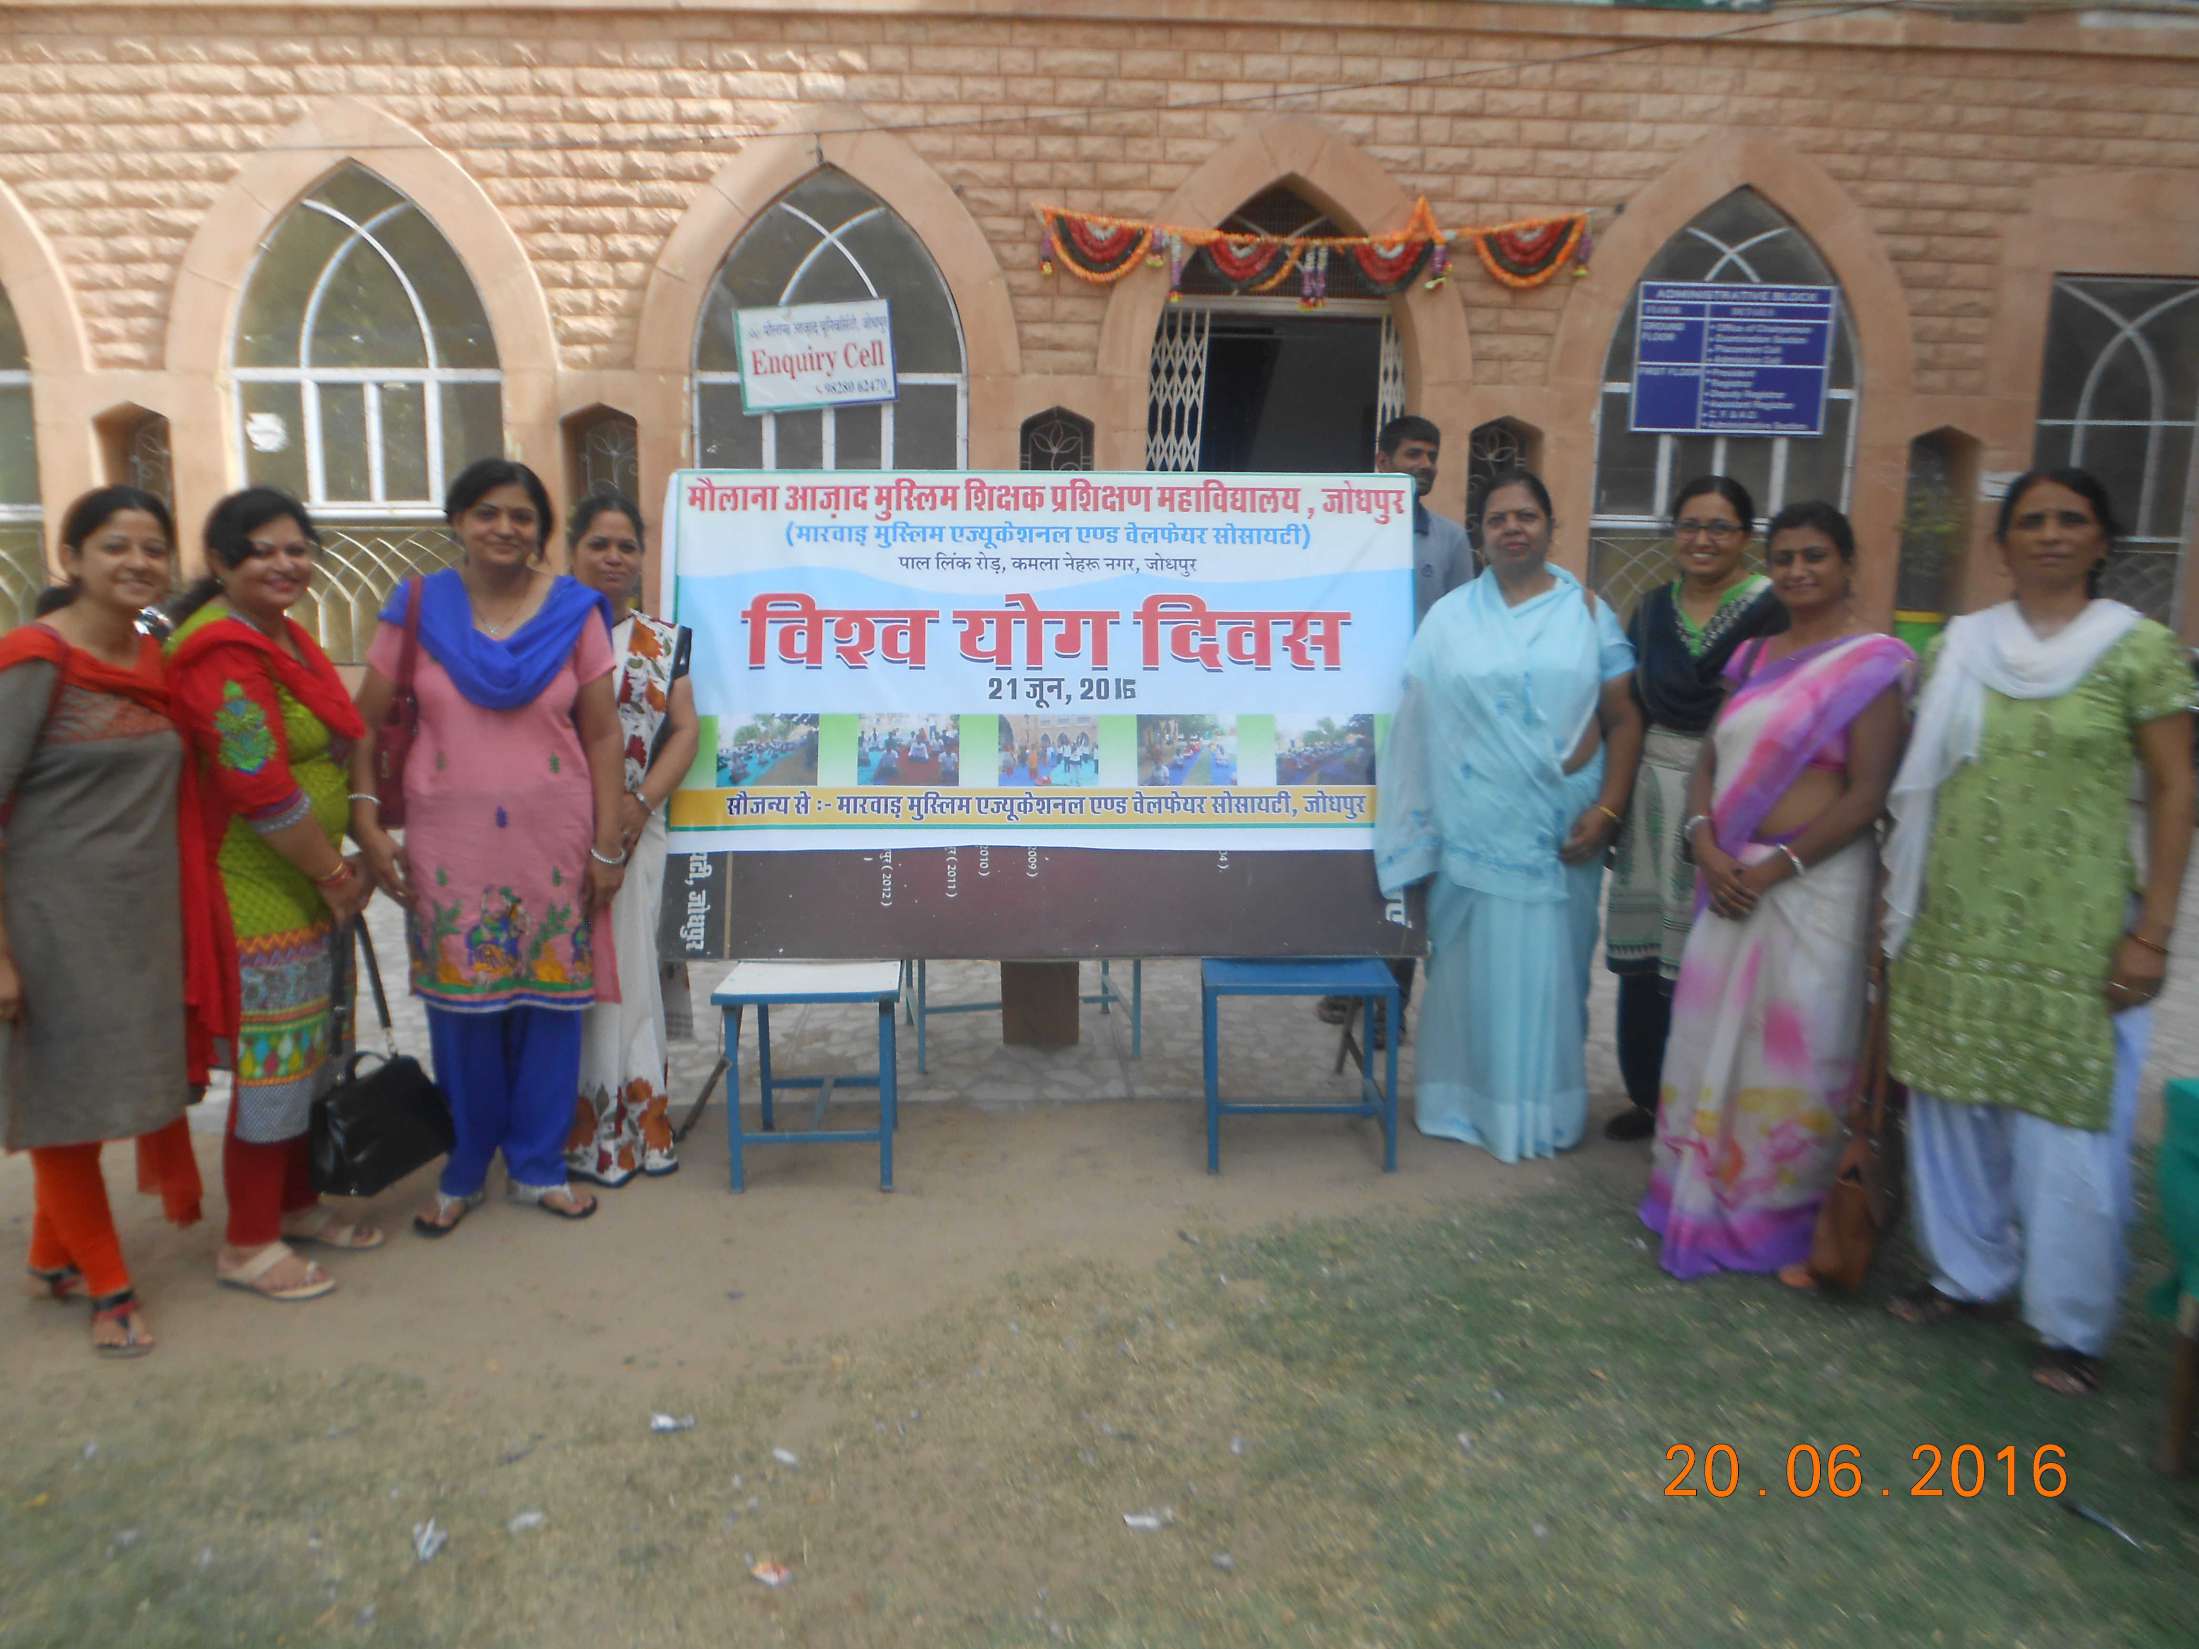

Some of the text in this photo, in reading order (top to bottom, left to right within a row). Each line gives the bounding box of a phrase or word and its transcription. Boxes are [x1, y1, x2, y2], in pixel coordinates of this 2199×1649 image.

[1655, 289, 1818, 302] ADMINISTRATIVE BLOCK
[752, 339, 886, 380] Enquiry Cell
[688, 477, 779, 512] मौलाना
[785, 484, 870, 519] आज़ाद
[874, 478, 960, 521] मुस्लिम
[964, 478, 1045, 512] शिक्षक
[1050, 478, 1152, 513] प्रशिक्षण
[1321, 481, 1405, 525] जोधपुर
[873, 521, 945, 549] मुस्लिम
[950, 521, 1073, 550] एज्यूकेशनल
[1077, 525, 1121, 545] एण्ड
[1125, 522, 1208, 545] वेलफेयर
[1213, 522, 1312, 550] सोसायटी)
[897, 551, 1199, 577] पाल लिंक रोड़, कमला नेहरू नगर, जोधपुर
[740, 592, 1352, 673] विश्व योग दिवस
[987, 677, 1017, 700] 21
[1023, 677, 1072, 709] जून,
[726, 790, 791, 816] सौजन्य
[794, 790, 812, 815] से
[837, 796, 904, 819] मारवाड़
[907, 792, 972, 821] मुस्लिम
[975, 792, 1086, 821] एज्यूकेशनल
[1089, 796, 1128, 815] एण्ड
[1131, 791, 1207, 815] वेलफेयर
[1211, 791, 1298, 818] सोसायटी,
[1303, 791, 1367, 820] जोधपुर
[679, 888, 712, 953] जोधपुर
